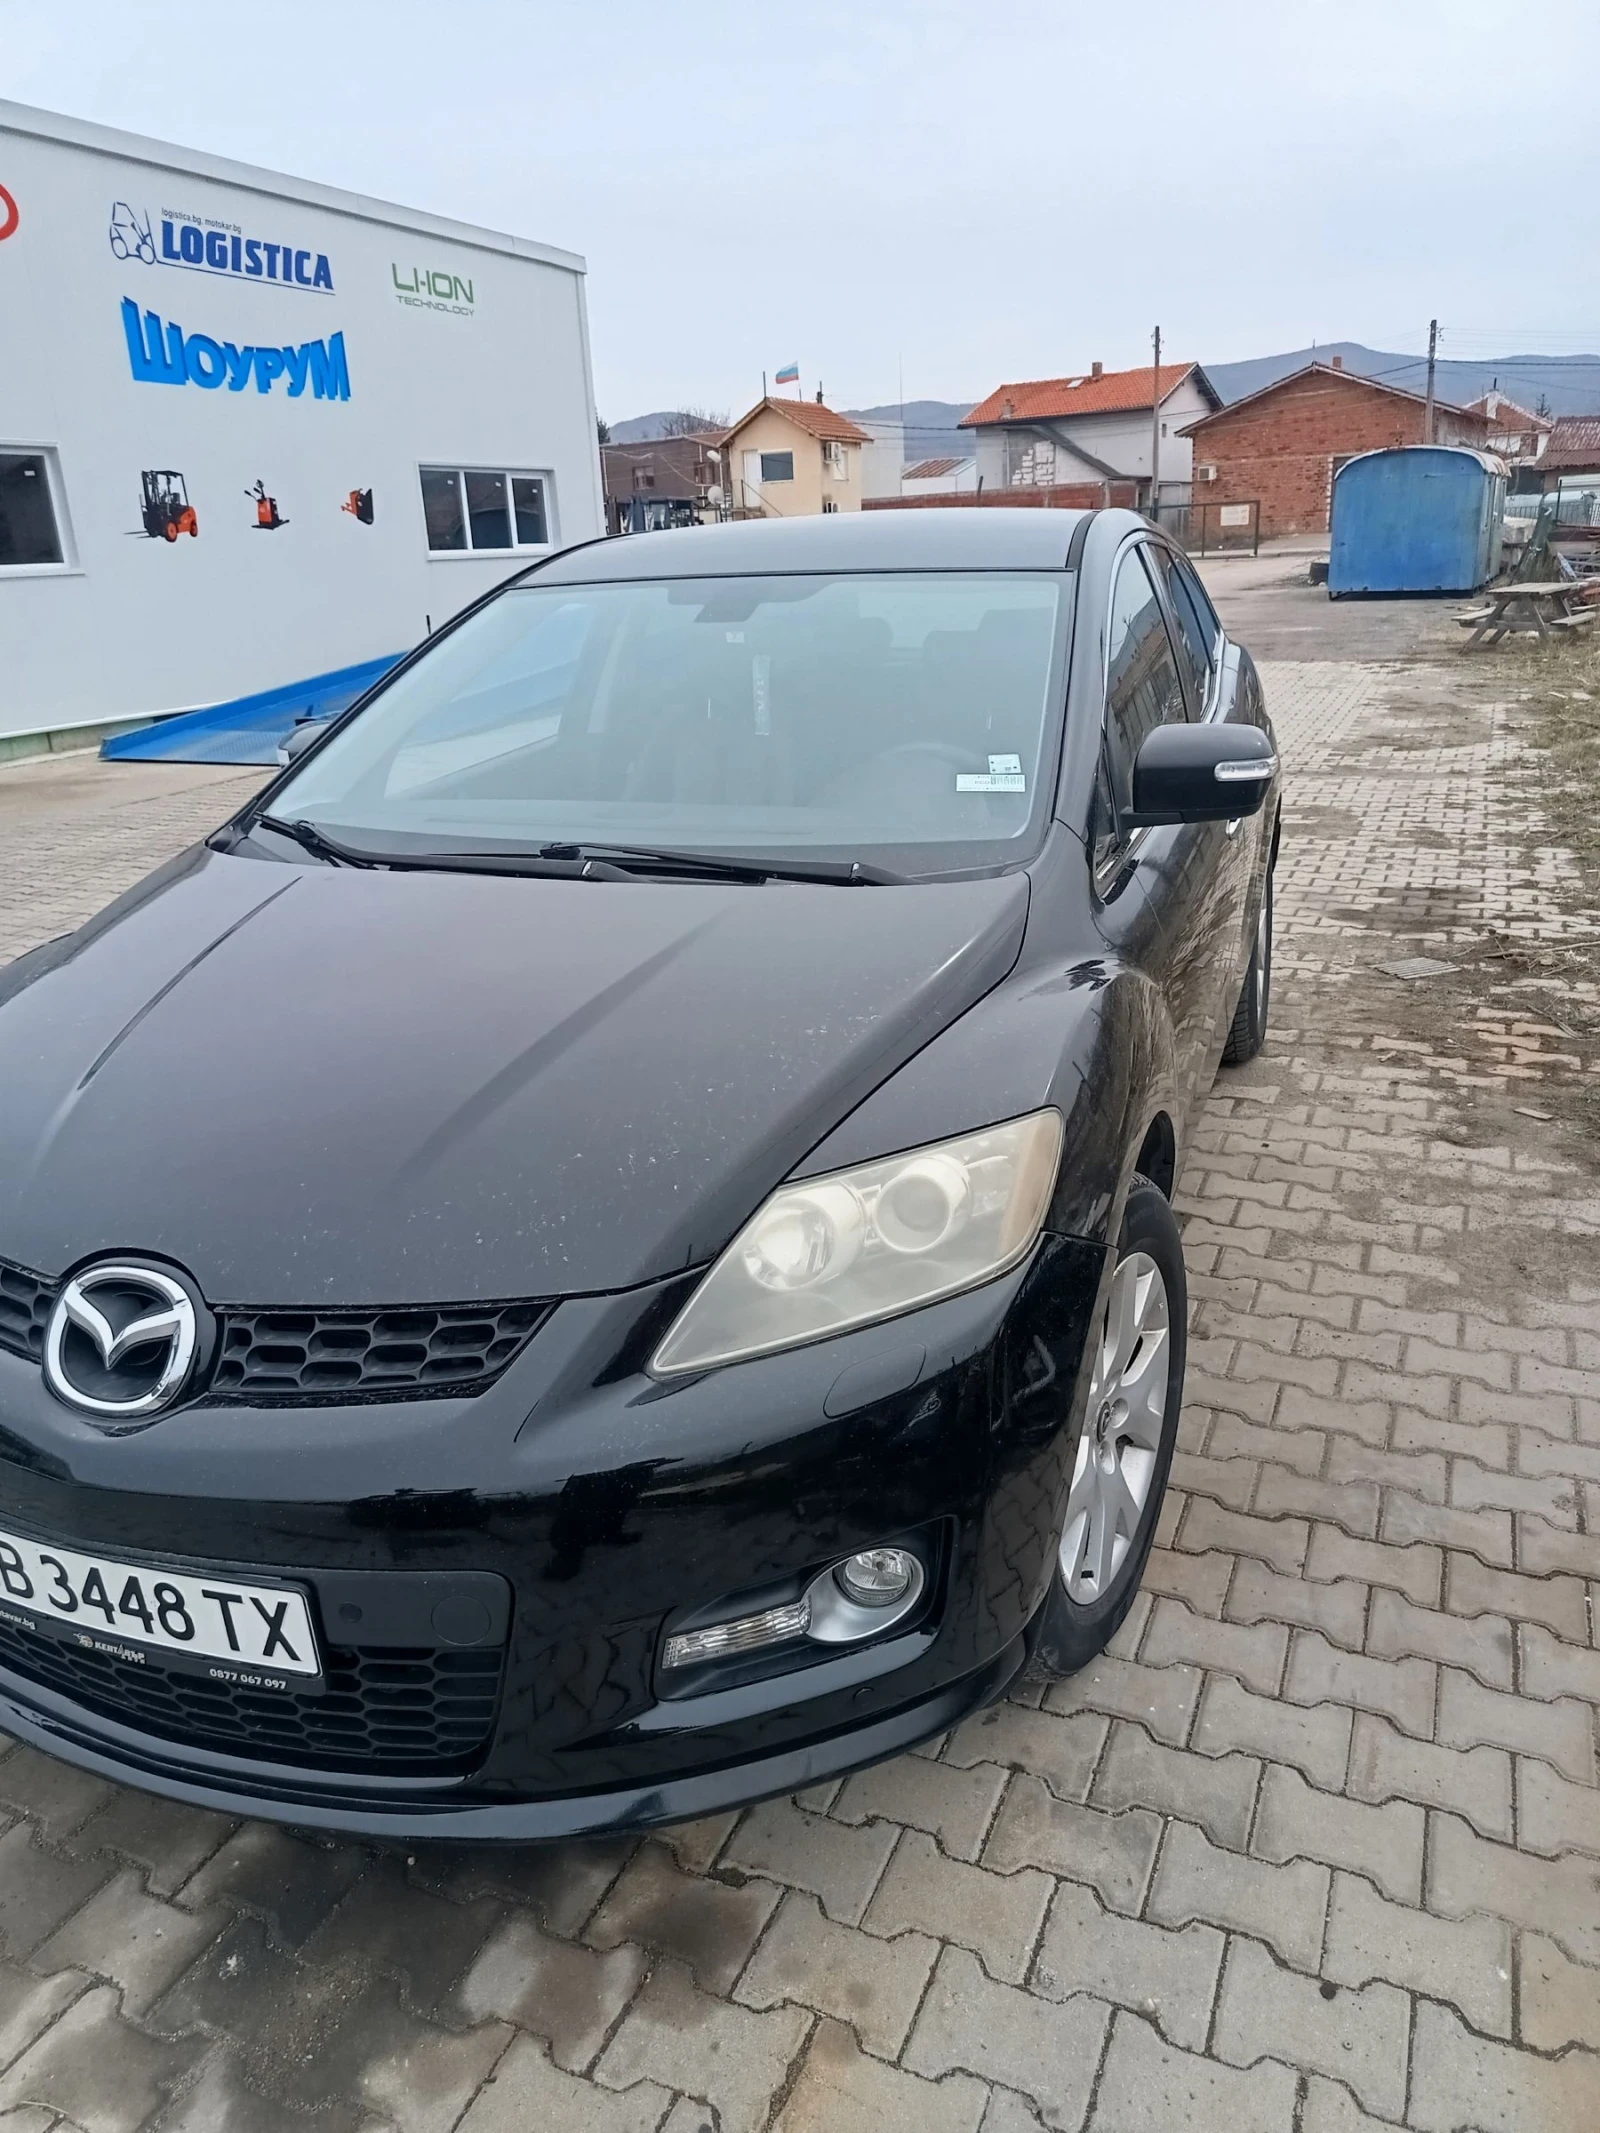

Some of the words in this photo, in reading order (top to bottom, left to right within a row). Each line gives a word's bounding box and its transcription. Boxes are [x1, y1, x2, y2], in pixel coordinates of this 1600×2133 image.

[205, 218, 242, 234] motokar.bg
[161, 219, 334, 290] LOGISTICA
[392, 263, 474, 304] LI-ION
[396, 295, 475, 317] TECHNOLOGY
[120, 295, 351, 402] ШОУРУМ
[209, 1668, 237, 1681] 0877
[240, 1674, 262, 1685] 067
[264, 1679, 286, 1690] 097
